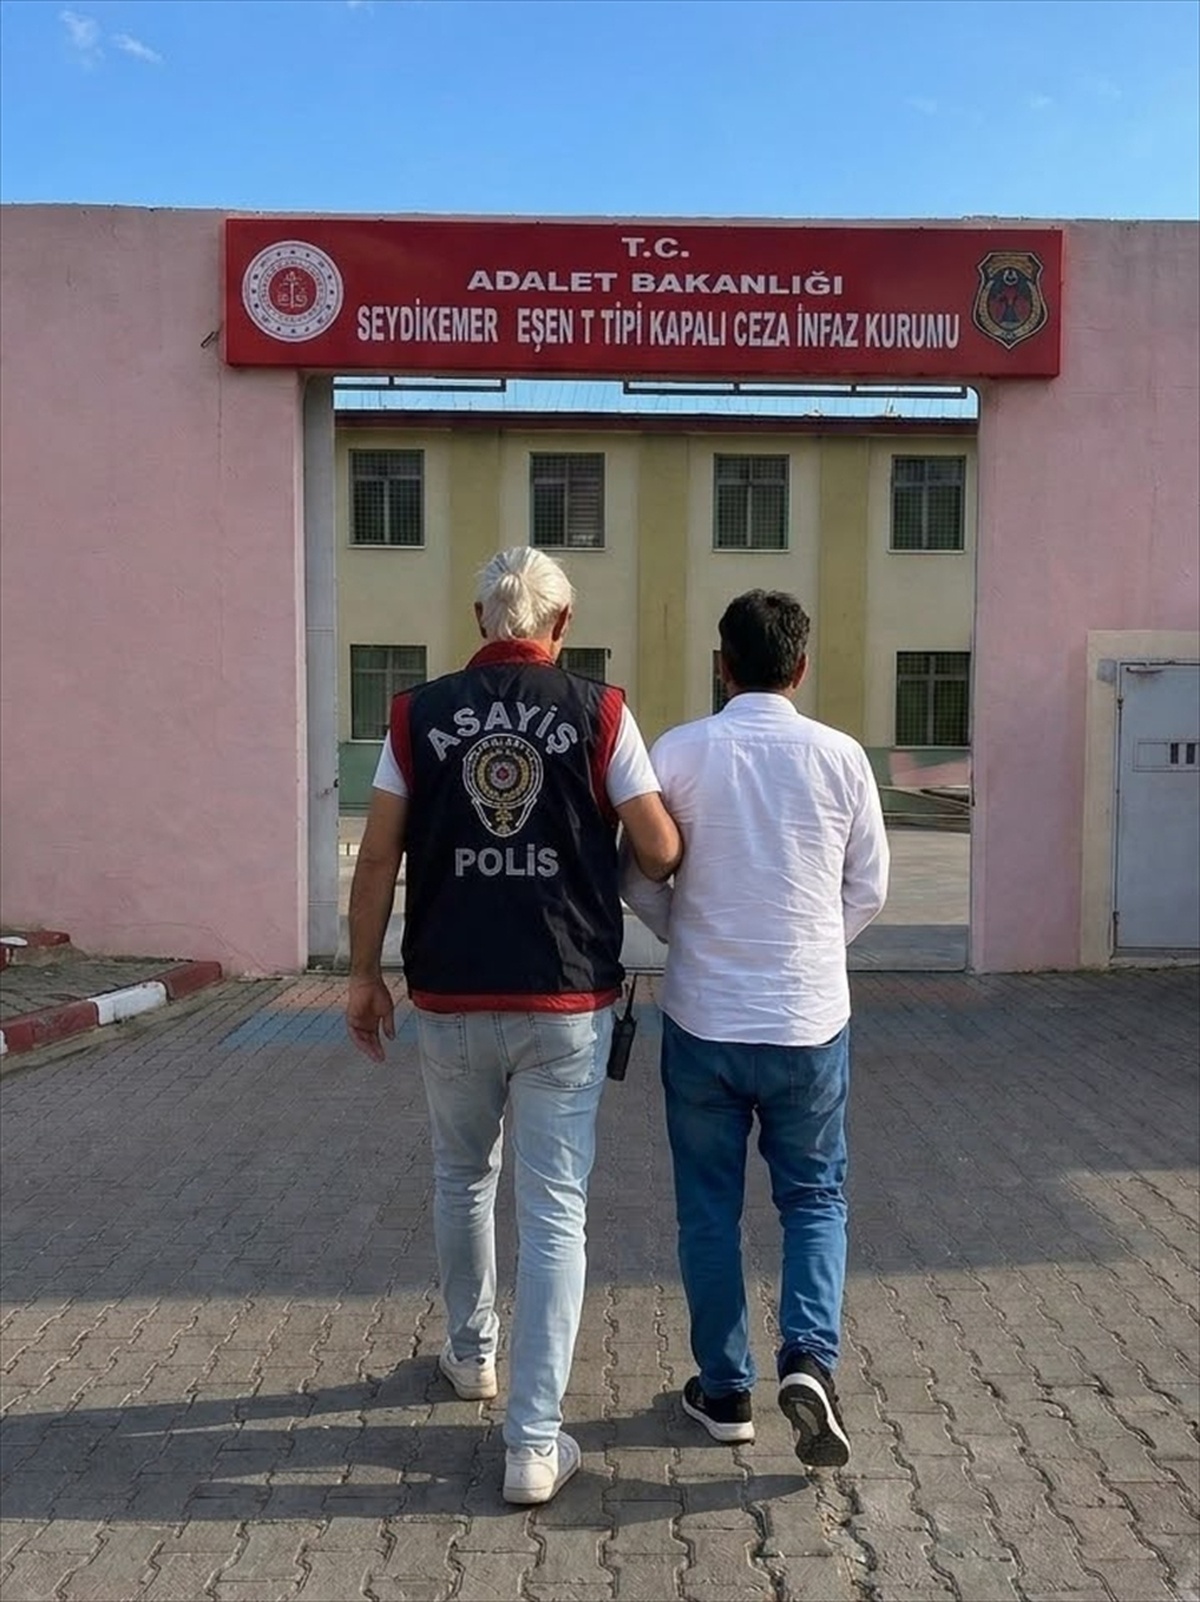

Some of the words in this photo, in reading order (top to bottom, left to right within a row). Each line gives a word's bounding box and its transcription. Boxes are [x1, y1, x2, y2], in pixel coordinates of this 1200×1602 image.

[621, 236, 690, 258] T.C.
[467, 270, 618, 292] ADALET
[631, 271, 842, 295] BAKANLIĞI
[357, 298, 499, 343] SEYDİKEMER
[517, 307, 573, 353] EŞEN
[581, 309, 595, 344] T
[601, 301, 642, 345] TİPİ
[650, 310, 728, 346] KAPALI
[733, 312, 790, 347] CEZA
[797, 302, 859, 349] İNFAZ
[864, 314, 961, 350] KURUMU
[427, 701, 578, 762] ASAYİŞ
[454, 844, 560, 878] POLİS
